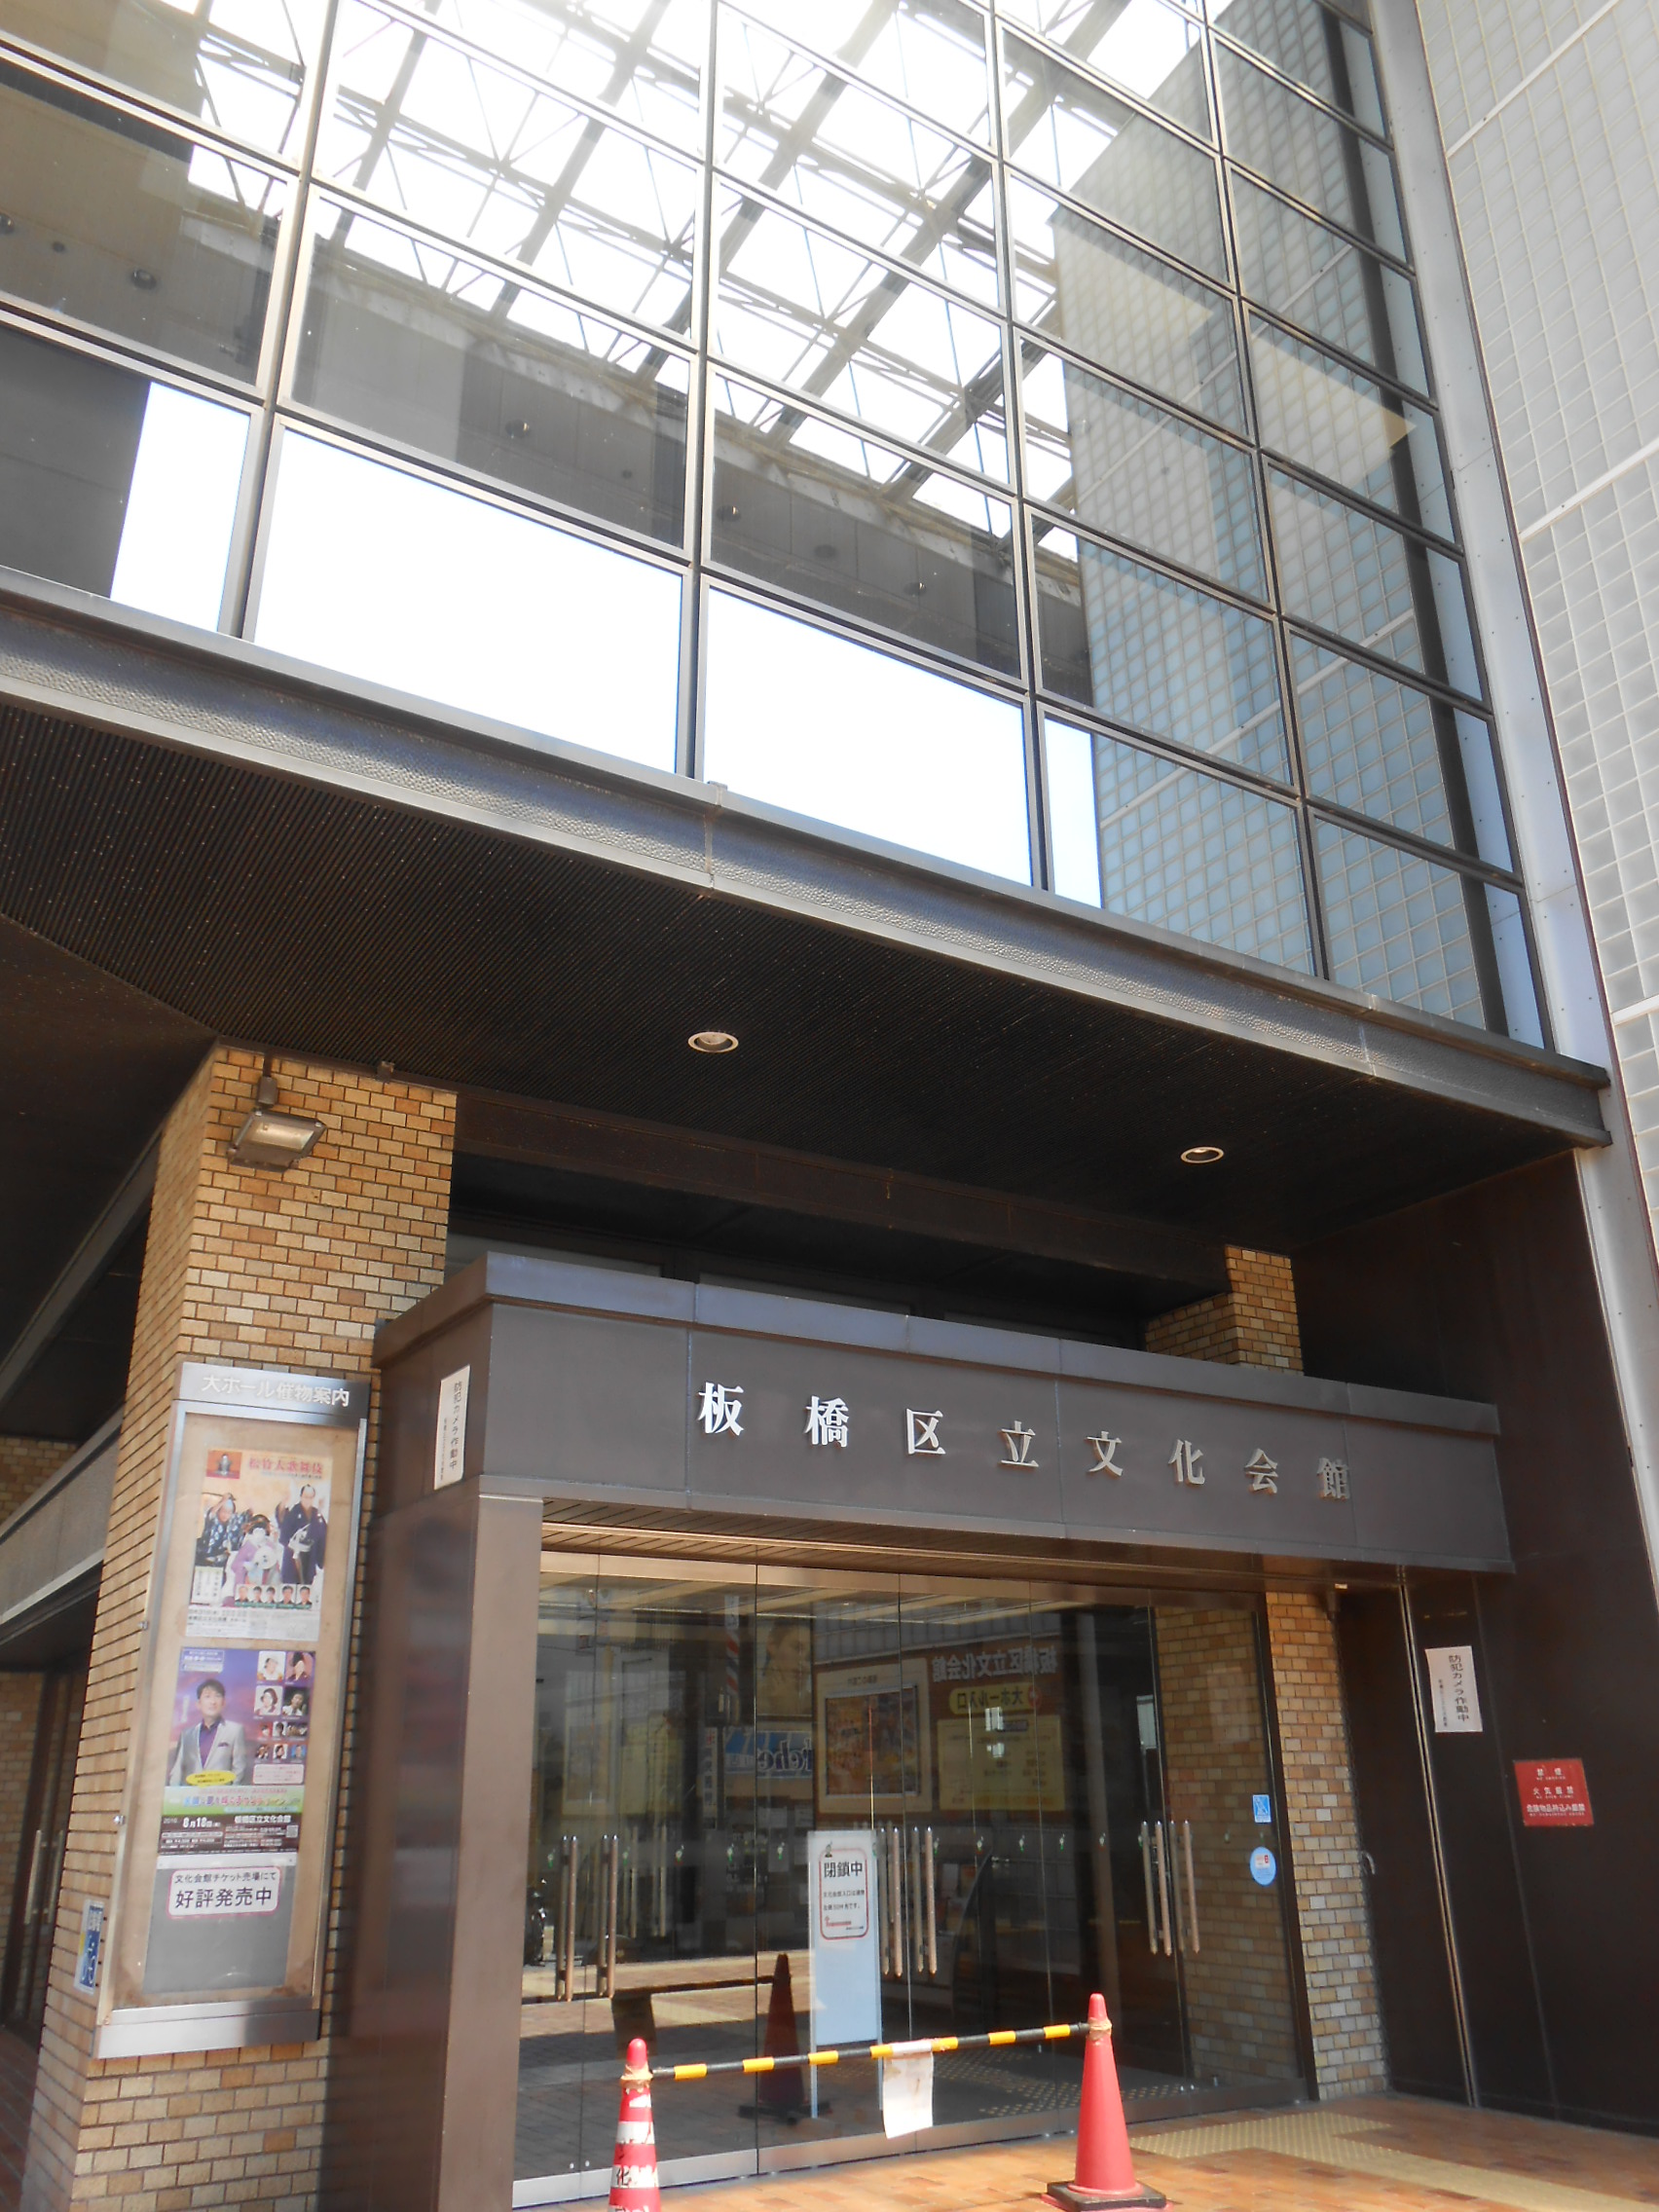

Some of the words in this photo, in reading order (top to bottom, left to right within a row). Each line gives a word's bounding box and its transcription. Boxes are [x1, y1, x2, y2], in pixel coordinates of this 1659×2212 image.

[201, 1374, 350, 1408] 大ホール催物案内
[449, 1380, 462, 1471] 防犯カメラ作動中
[697, 1381, 1351, 1501] 板橋区立文化会館
[1449, 1654, 1470, 1722] 防犯カメラ作動中
[174, 1871, 276, 1884] 文化会館チケット売場にて
[824, 1861, 863, 1878] 閉鎖中
[175, 1887, 272, 1909] 好評発売中
